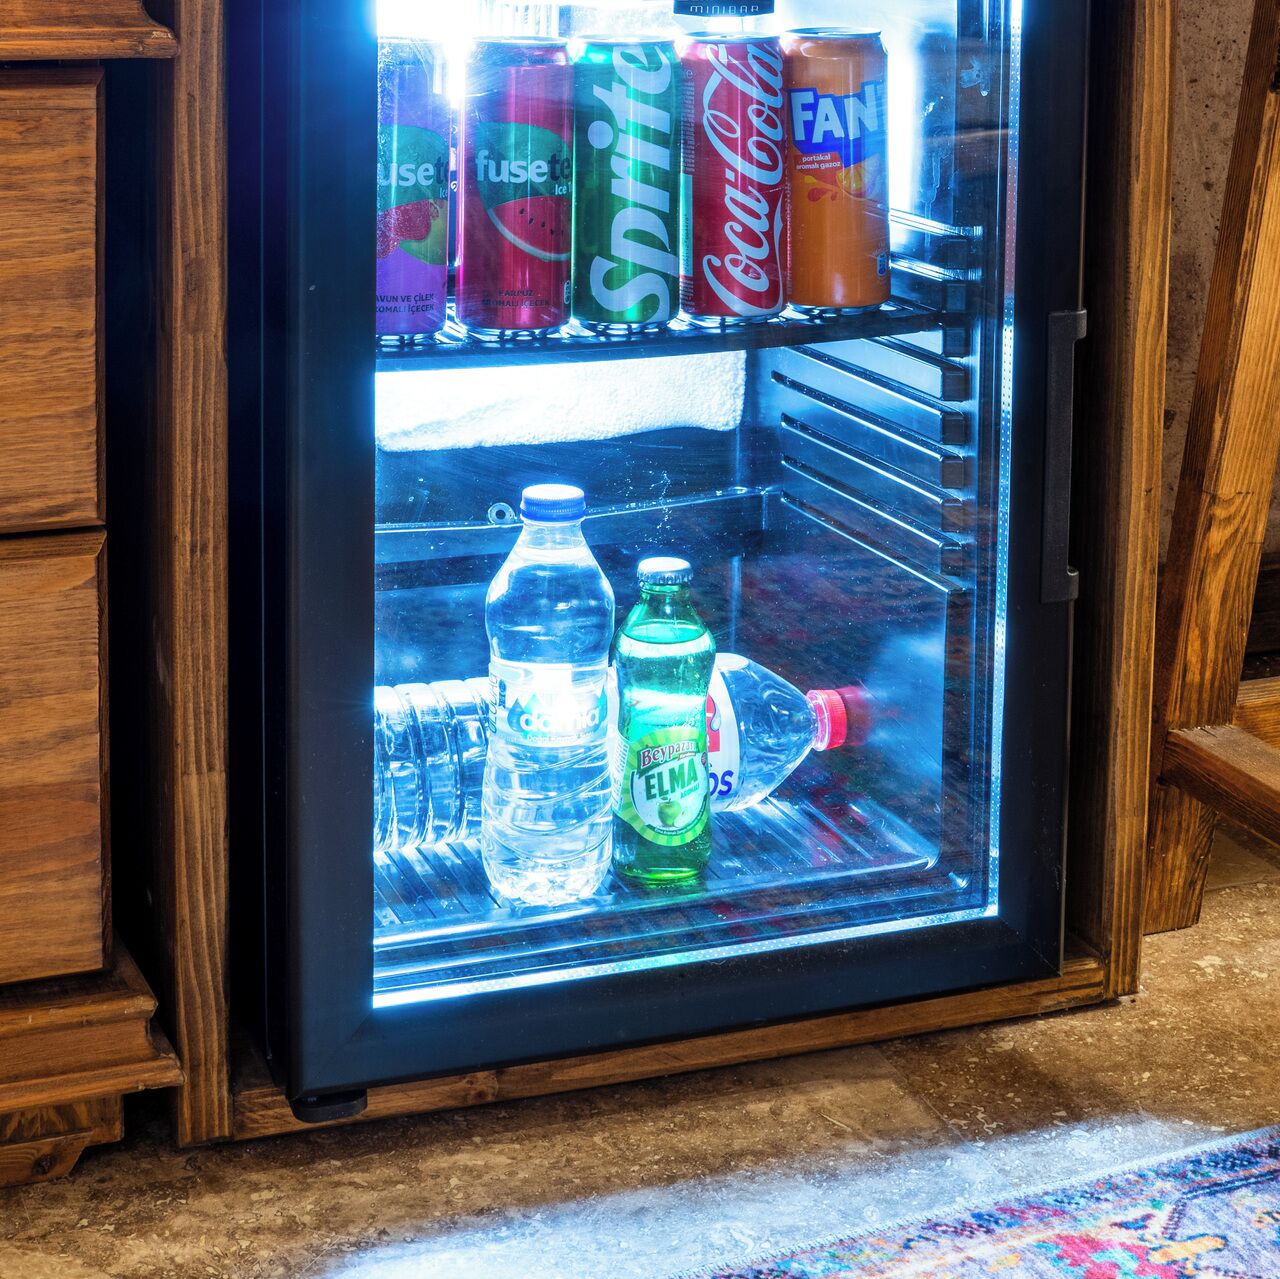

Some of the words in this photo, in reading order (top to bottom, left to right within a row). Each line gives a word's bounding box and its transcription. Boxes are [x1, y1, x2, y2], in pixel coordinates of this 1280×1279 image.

[587, 45, 680, 323] Sprite
[400, 295, 412, 303] VE
[644, 757, 699, 801] ELMA
